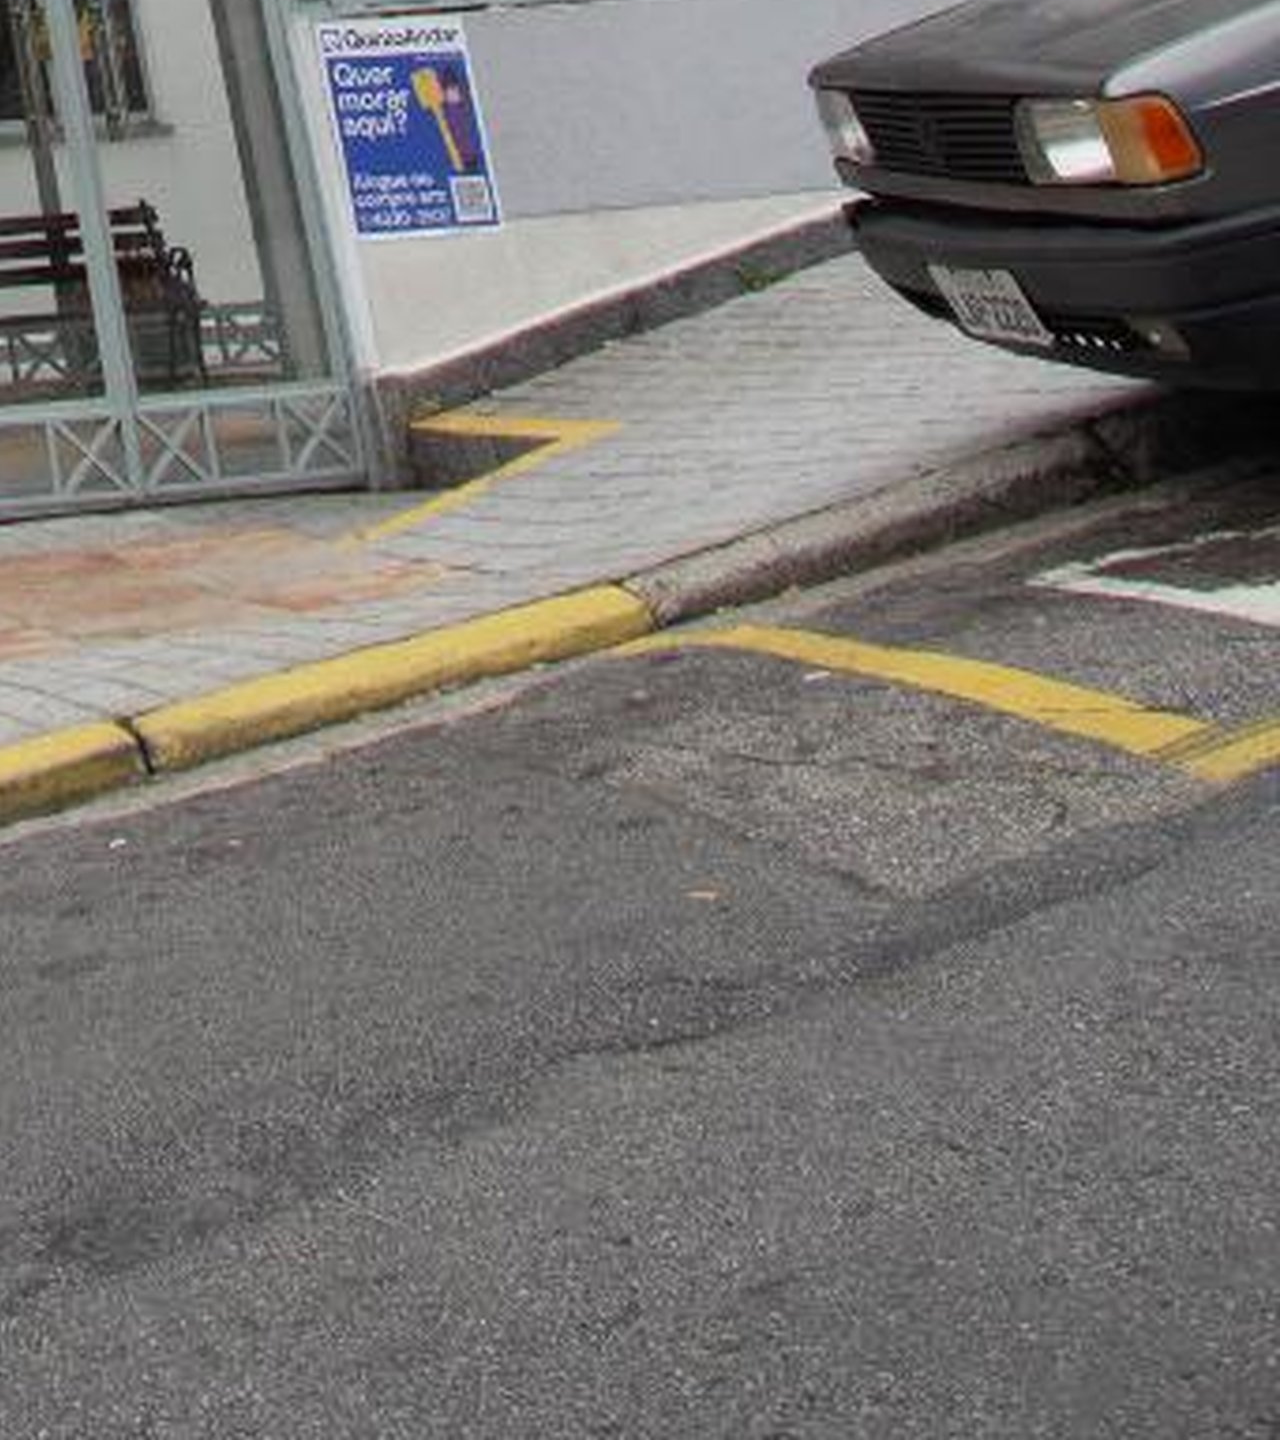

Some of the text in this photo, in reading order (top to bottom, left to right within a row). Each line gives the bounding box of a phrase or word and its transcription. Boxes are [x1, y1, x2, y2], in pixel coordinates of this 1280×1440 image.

[333, 62, 395, 88] Quer
[338, 89, 410, 113] morar
[342, 110, 408, 142] aqui?
